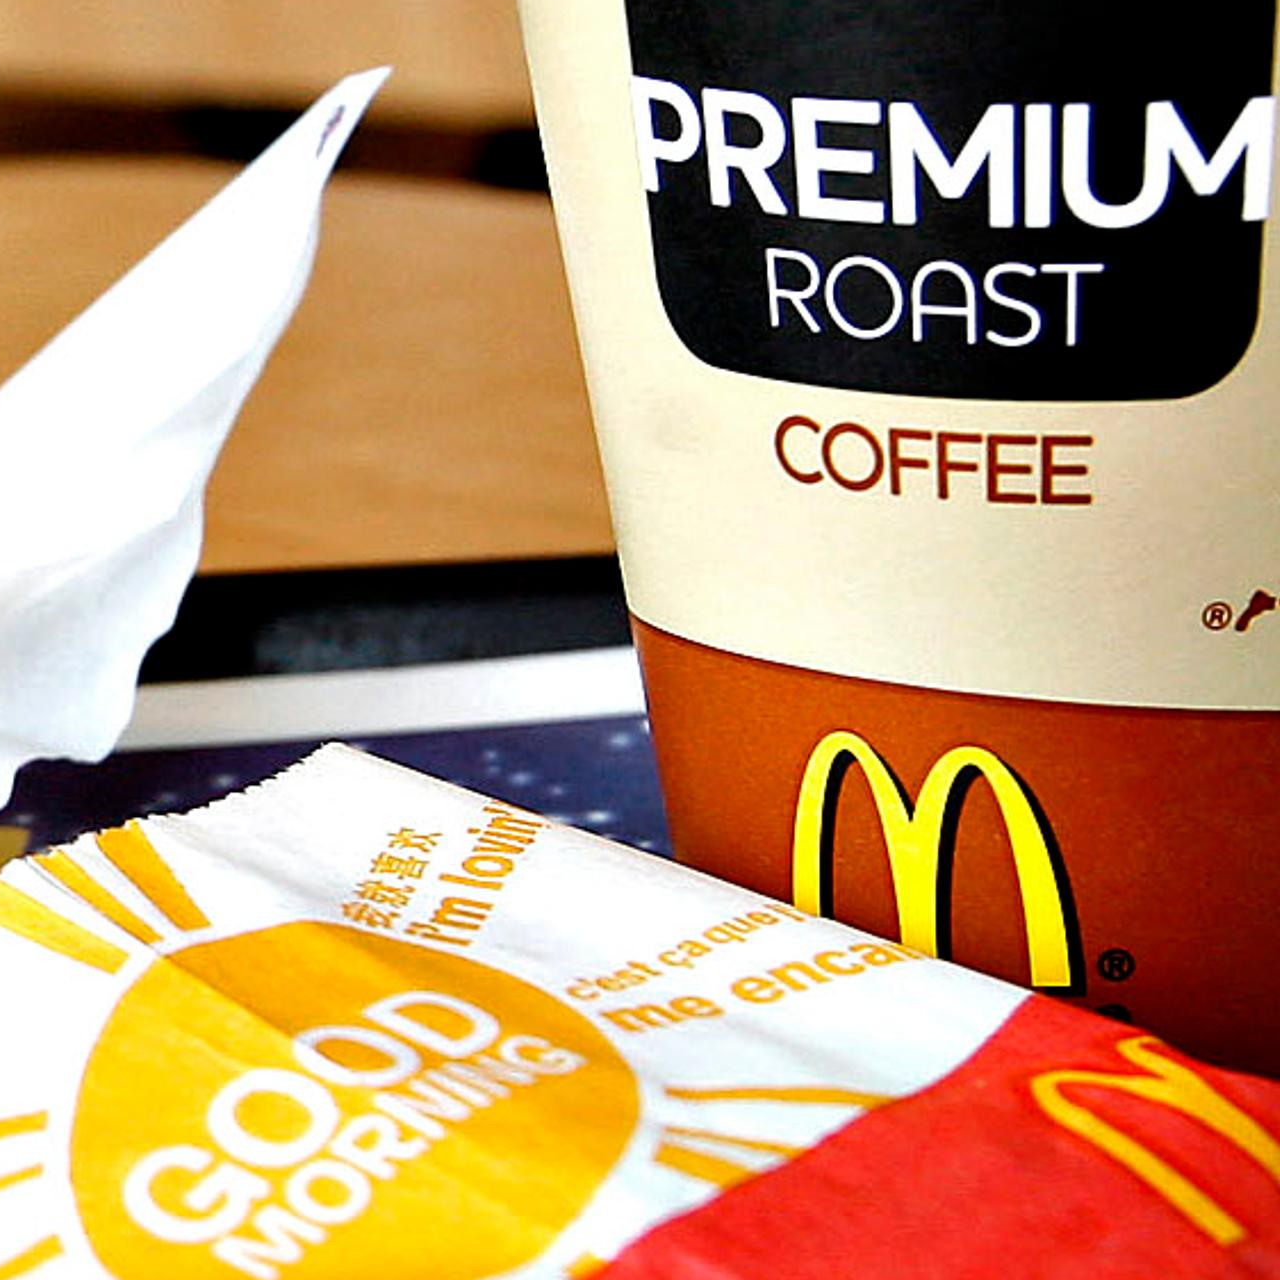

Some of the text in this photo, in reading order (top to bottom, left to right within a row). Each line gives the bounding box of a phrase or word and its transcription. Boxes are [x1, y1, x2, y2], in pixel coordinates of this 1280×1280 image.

[631, 73, 1277, 230] PREMIUM
[765, 246, 1104, 348] ROAST
[774, 414, 1094, 506] COFFEE
[564, 960, 663, 1002] c'est
[657, 938, 712, 969] ça
[701, 909, 780, 943] que
[599, 995, 725, 1034] me
[122, 990, 502, 1244] GOOD
